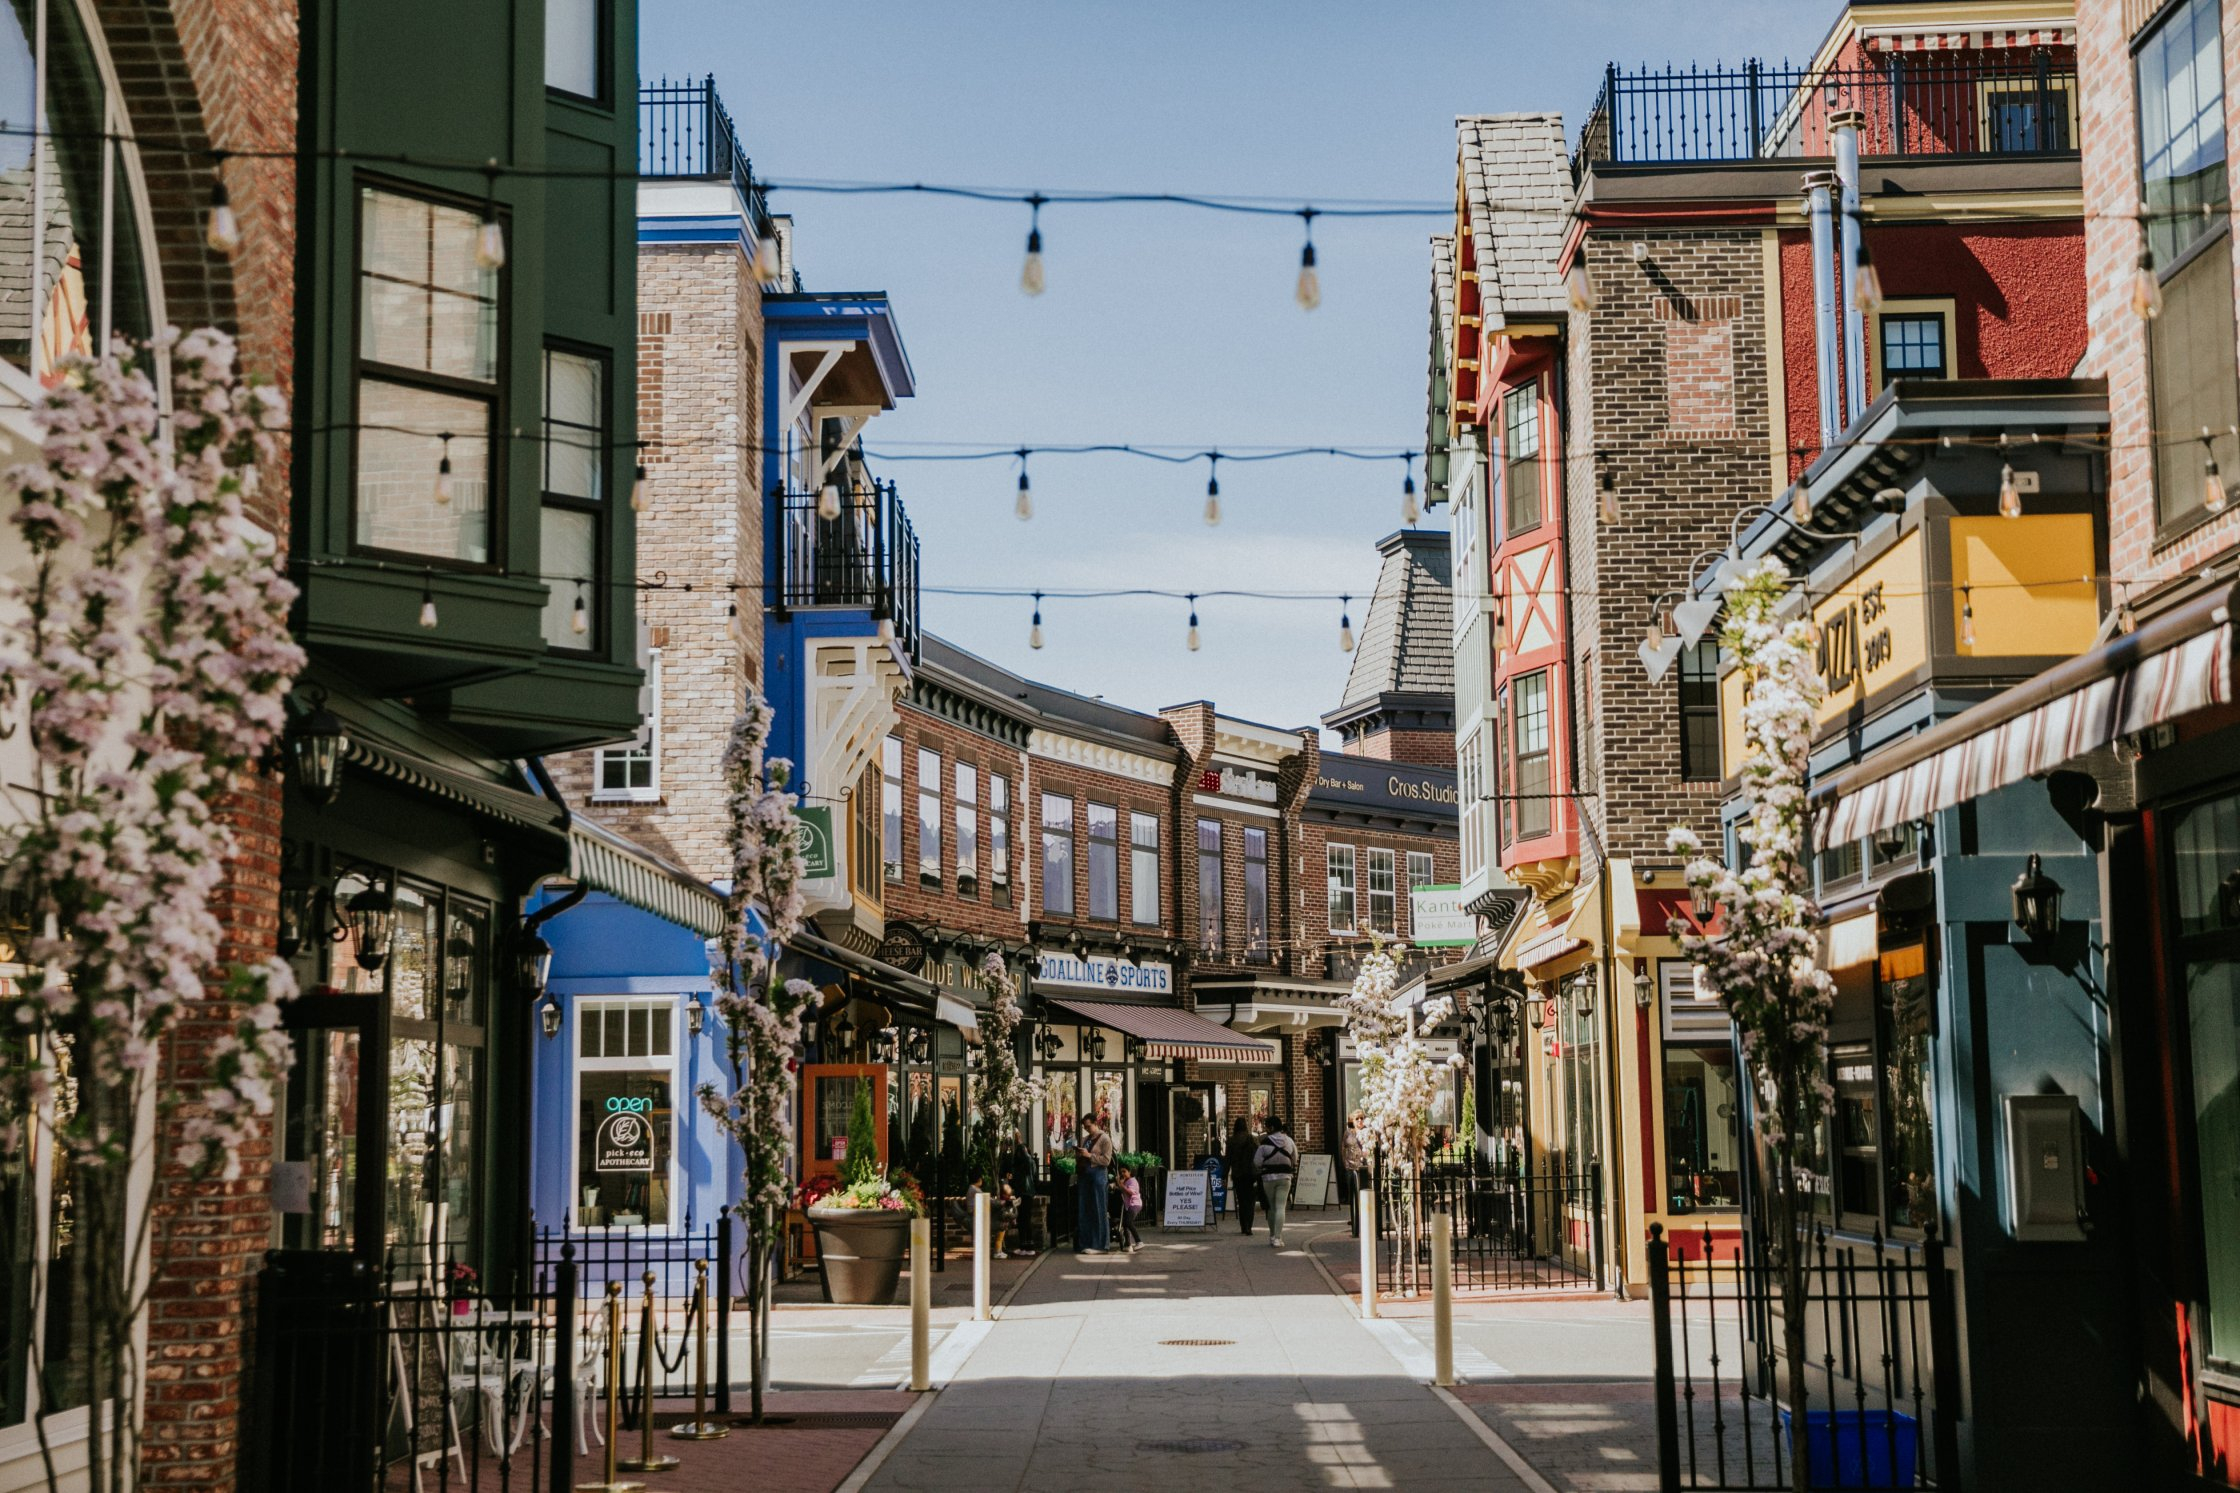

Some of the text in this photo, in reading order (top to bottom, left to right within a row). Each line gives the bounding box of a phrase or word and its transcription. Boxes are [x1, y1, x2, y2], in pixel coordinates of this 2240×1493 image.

[1319, 776, 1330, 789] Dry
[1330, 777, 1341, 788] Bar
[1347, 780, 1364, 791] Salon
[1447, 921, 1473, 929] Mart
[877, 945, 923, 956] HEESE BAR
[962, 965, 987, 991] WIN
[1041, 957, 1167, 989] GOALLINE SPORTS
[606, 1096, 652, 1112] open
